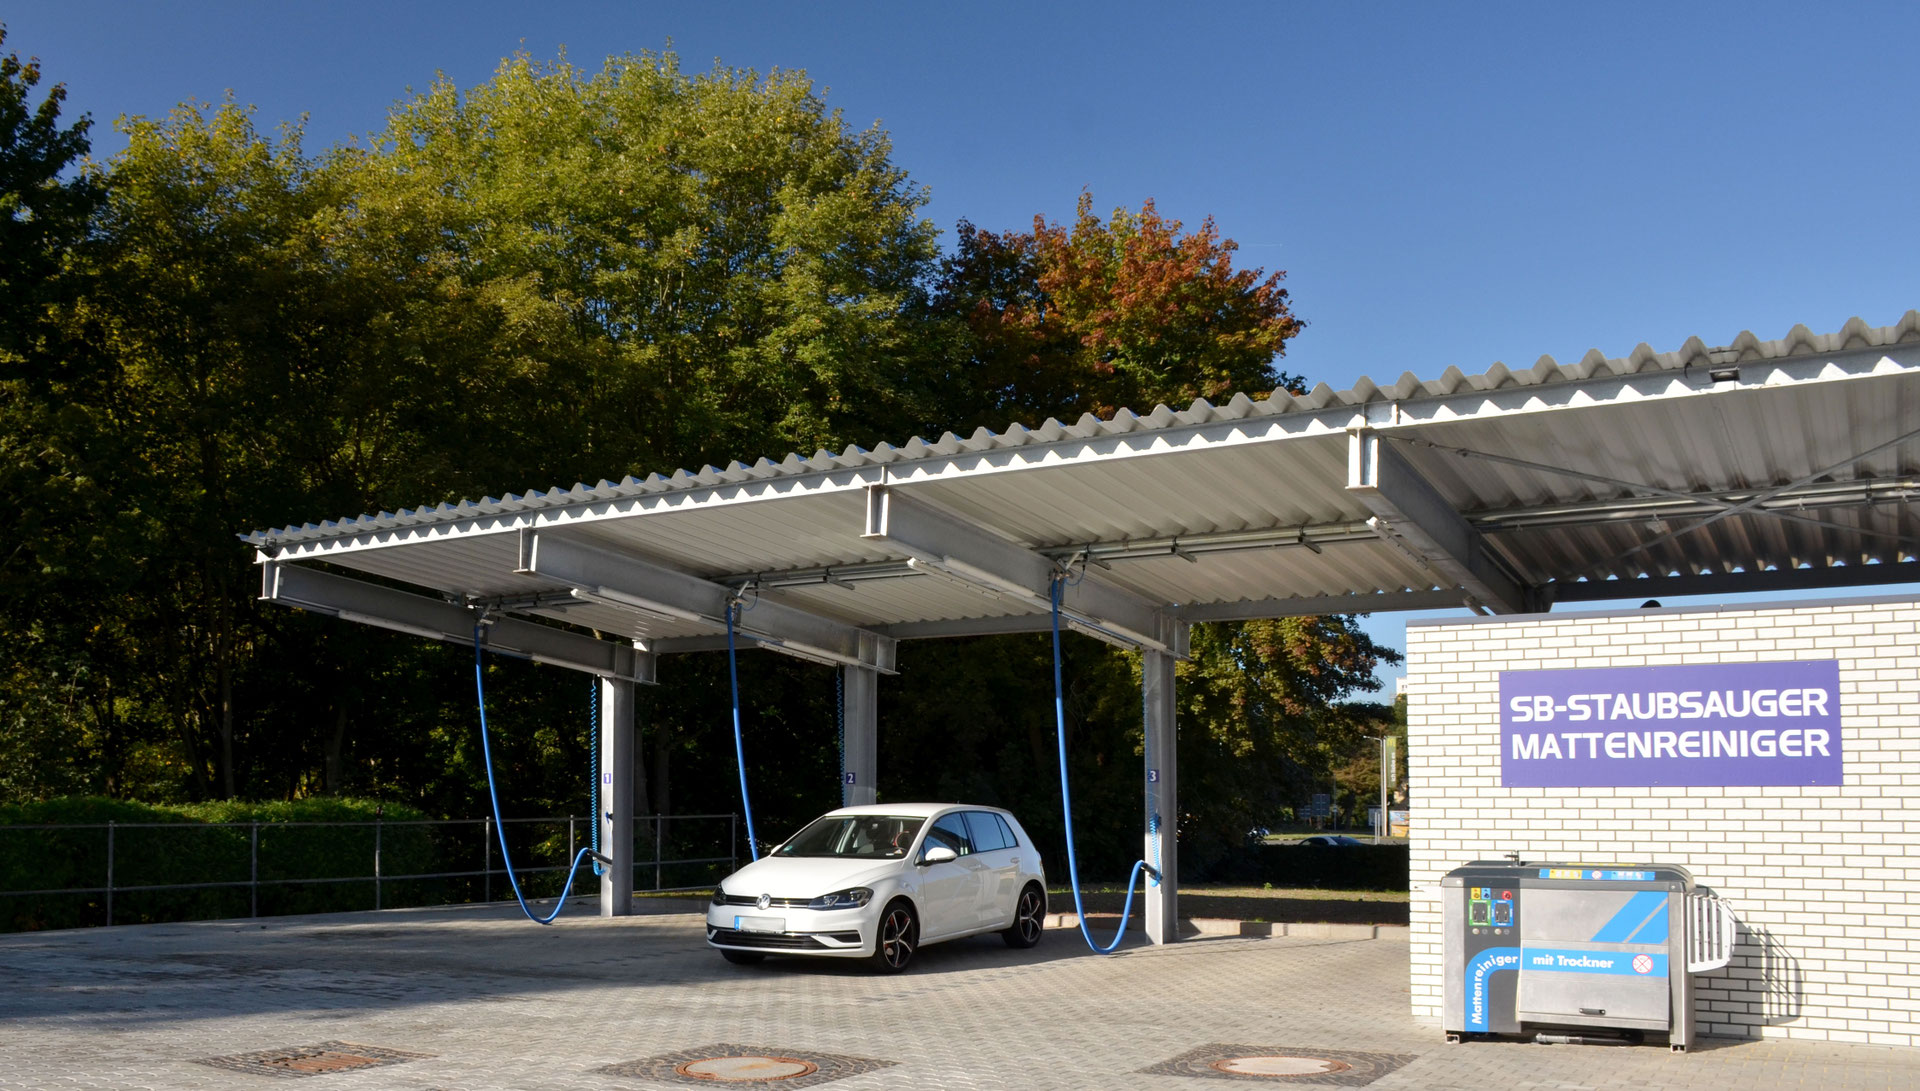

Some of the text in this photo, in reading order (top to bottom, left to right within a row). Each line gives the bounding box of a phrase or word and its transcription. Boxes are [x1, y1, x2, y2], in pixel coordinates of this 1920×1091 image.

[1509, 688, 1829, 723] SB-STAUBSAUGER
[1512, 729, 1831, 760] MATTENREINIGER
[847, 773, 854, 784] 2
[1150, 770, 1157, 782] 3
[1471, 954, 1614, 1025] Mattenreiniger mit Trockner
